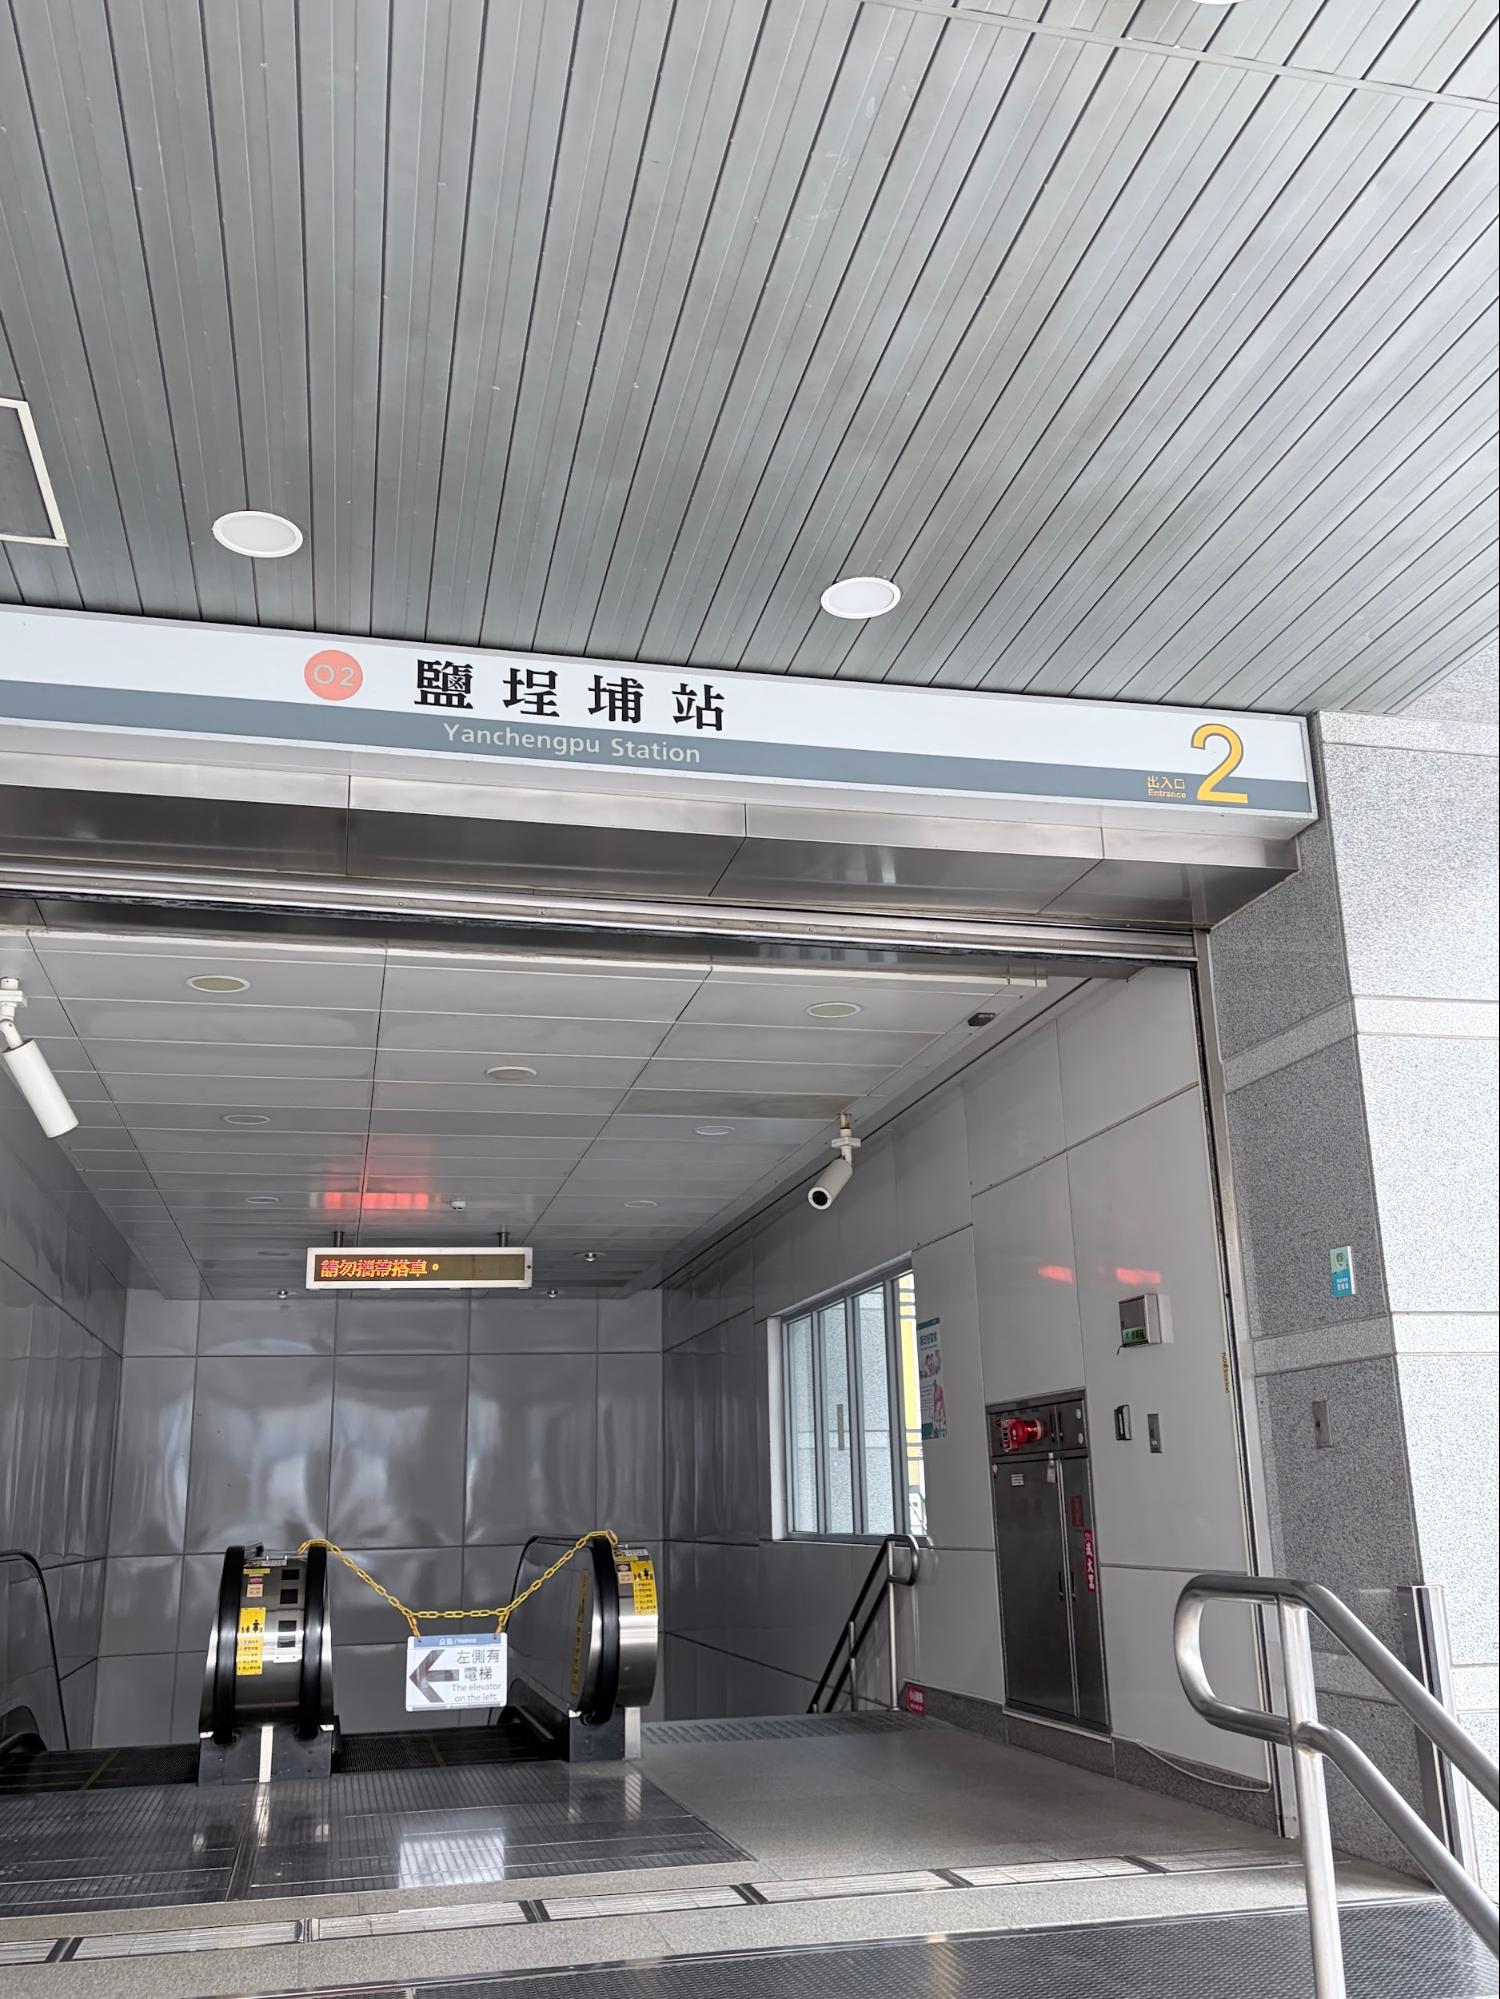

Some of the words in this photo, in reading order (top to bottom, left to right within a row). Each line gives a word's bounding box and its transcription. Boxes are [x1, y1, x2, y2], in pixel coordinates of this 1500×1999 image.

[413, 659, 725, 732] 鹽埕埔站
[443, 722, 600, 756] Yanchengpu
[611, 737, 701, 764] Station
[1190, 723, 1249, 804] 2
[1147, 775, 1185, 790] 出入口
[1147, 789, 1187, 799] Entrance
[456, 1648, 500, 1664] 左側有
[464, 1666, 493, 1681] 電梯
[452, 1684, 467, 1692] The
[469, 1682, 502, 1691] elevator
[454, 1695, 466, 1703] on
[467, 1694, 481, 1702] the
